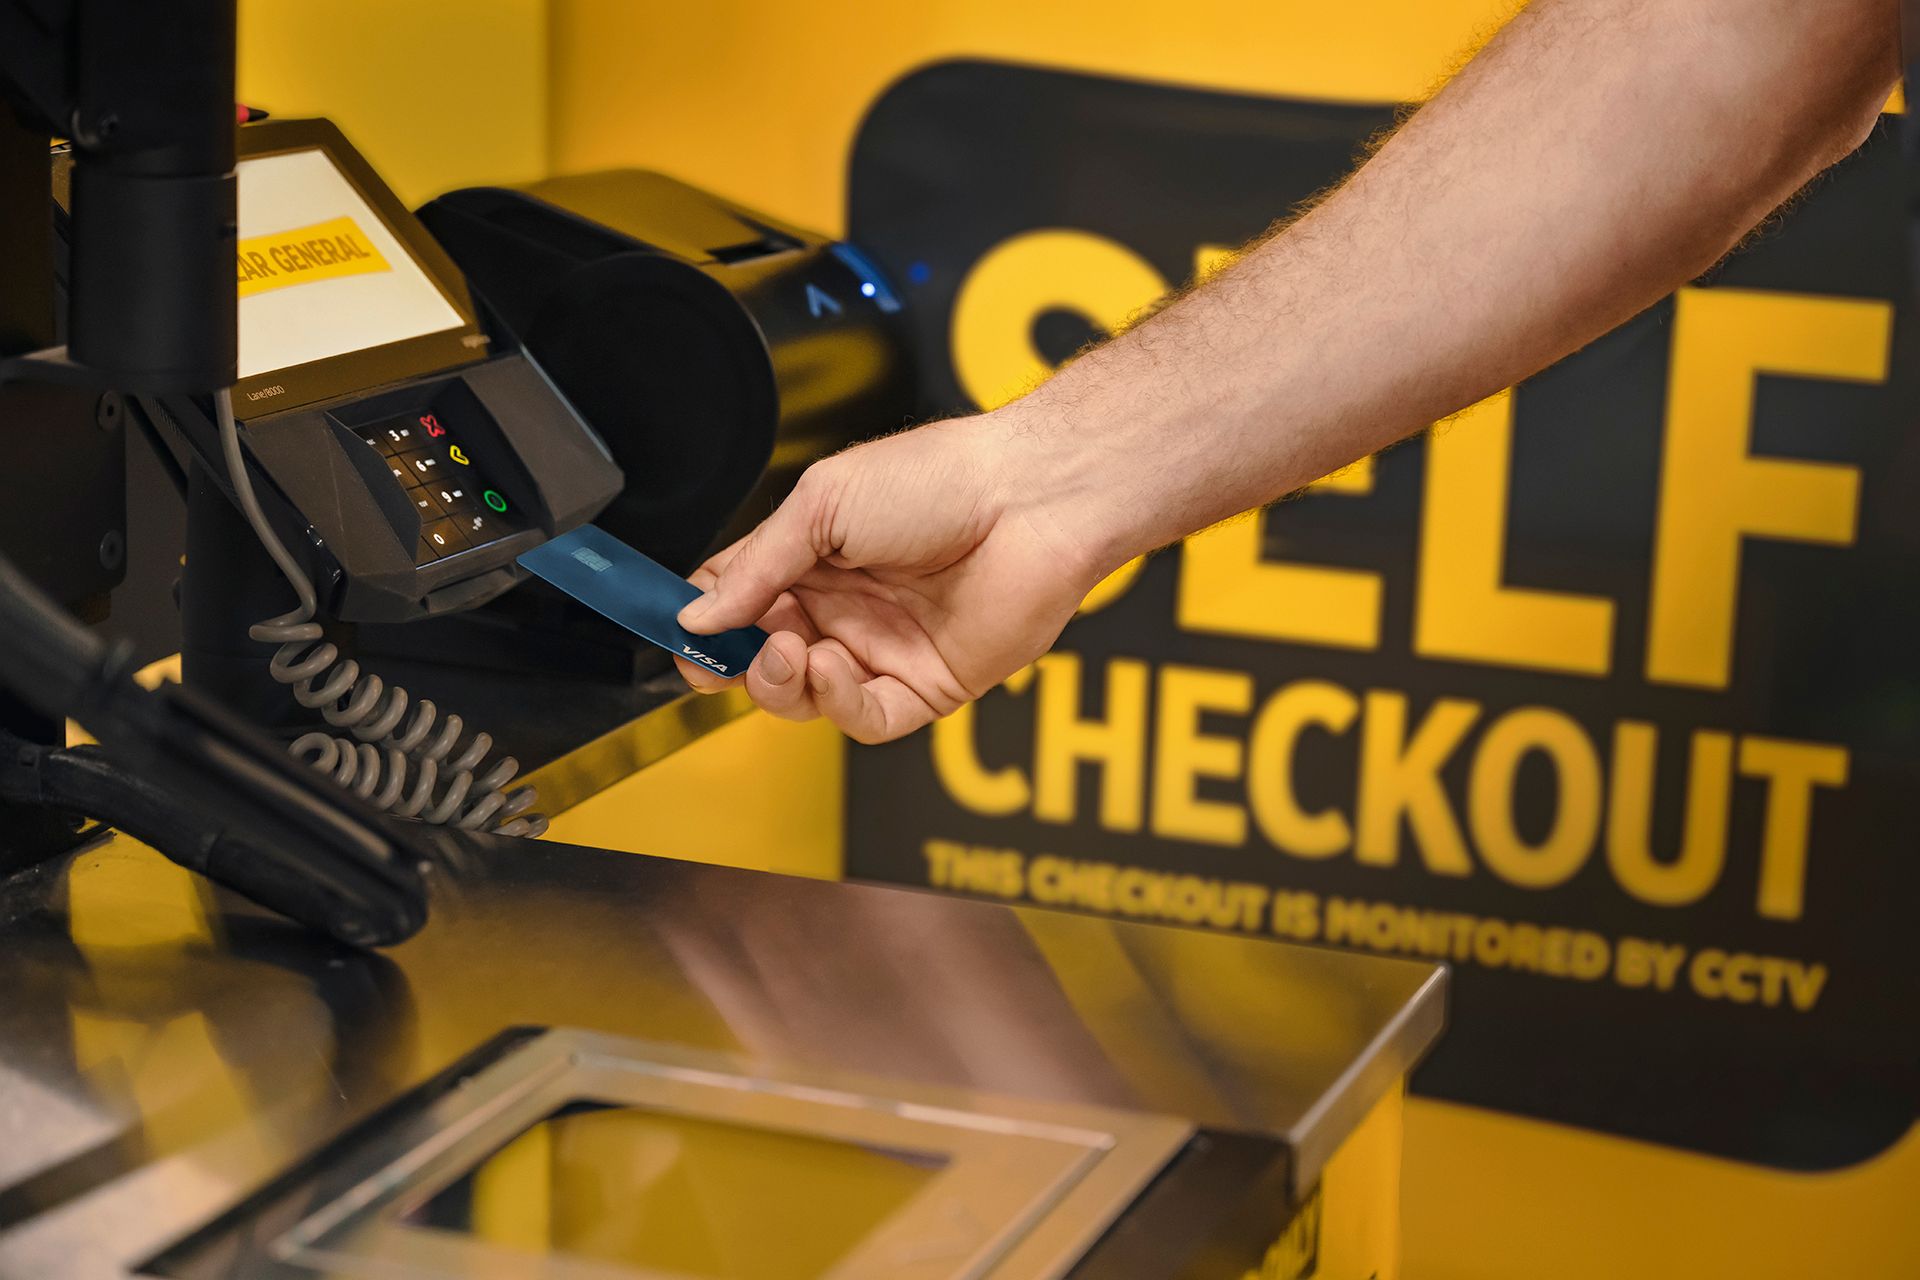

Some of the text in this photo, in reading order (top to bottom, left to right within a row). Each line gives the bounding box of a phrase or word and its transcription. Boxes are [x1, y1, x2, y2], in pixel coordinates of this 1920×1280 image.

[269, 234, 371, 274] GENERAL
[247, 385, 285, 401] Lane/8000
[388, 430, 400, 441] 3
[415, 460, 427, 472] 6
[441, 491, 453, 503] 9
[433, 533, 445, 545] 0
[682, 644, 728, 673] VISA
[930, 652, 1850, 922] CHECKOUT
[923, 839, 1828, 1011] THIS CHECKOUT IS MONITORED BY CCTV
